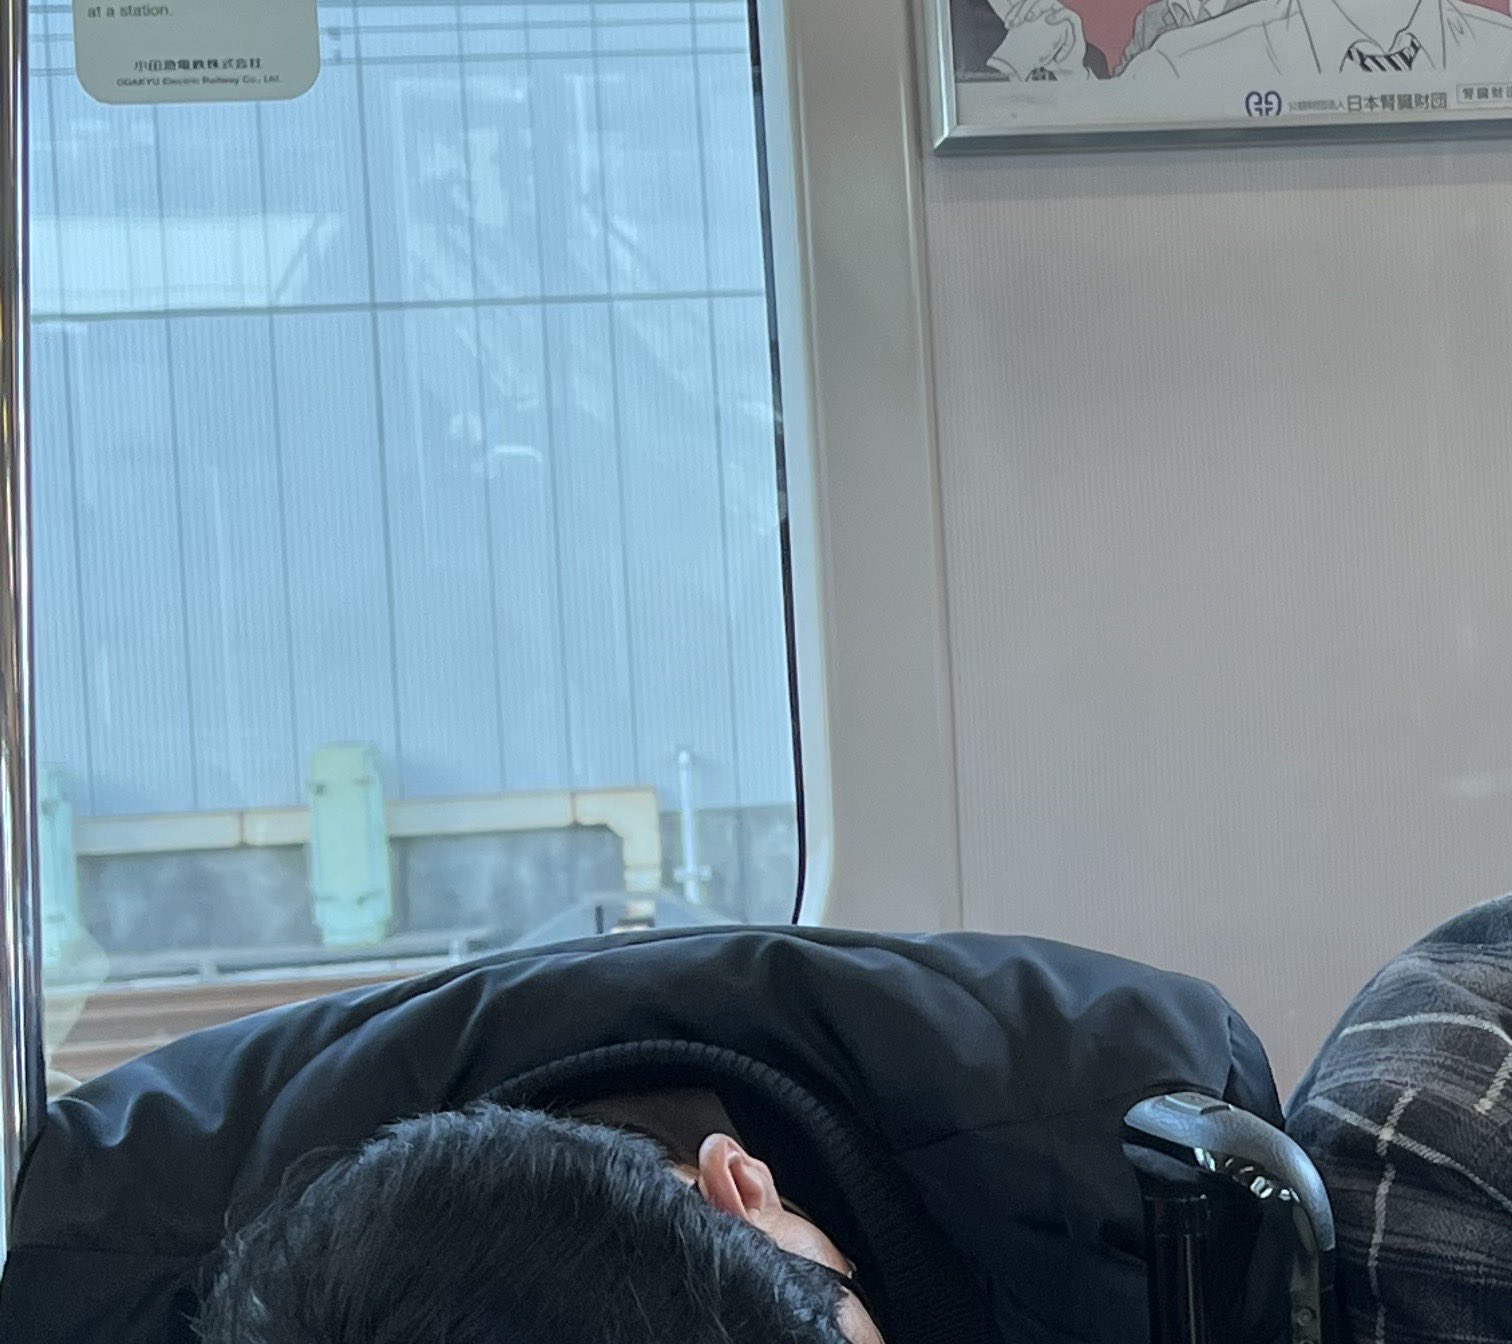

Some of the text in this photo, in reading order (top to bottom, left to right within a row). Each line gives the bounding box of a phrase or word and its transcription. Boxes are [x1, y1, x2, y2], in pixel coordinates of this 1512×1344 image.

[87, 5, 173, 18] at a station.
[1347, 91, 1448, 112] 日本腎臓財団
